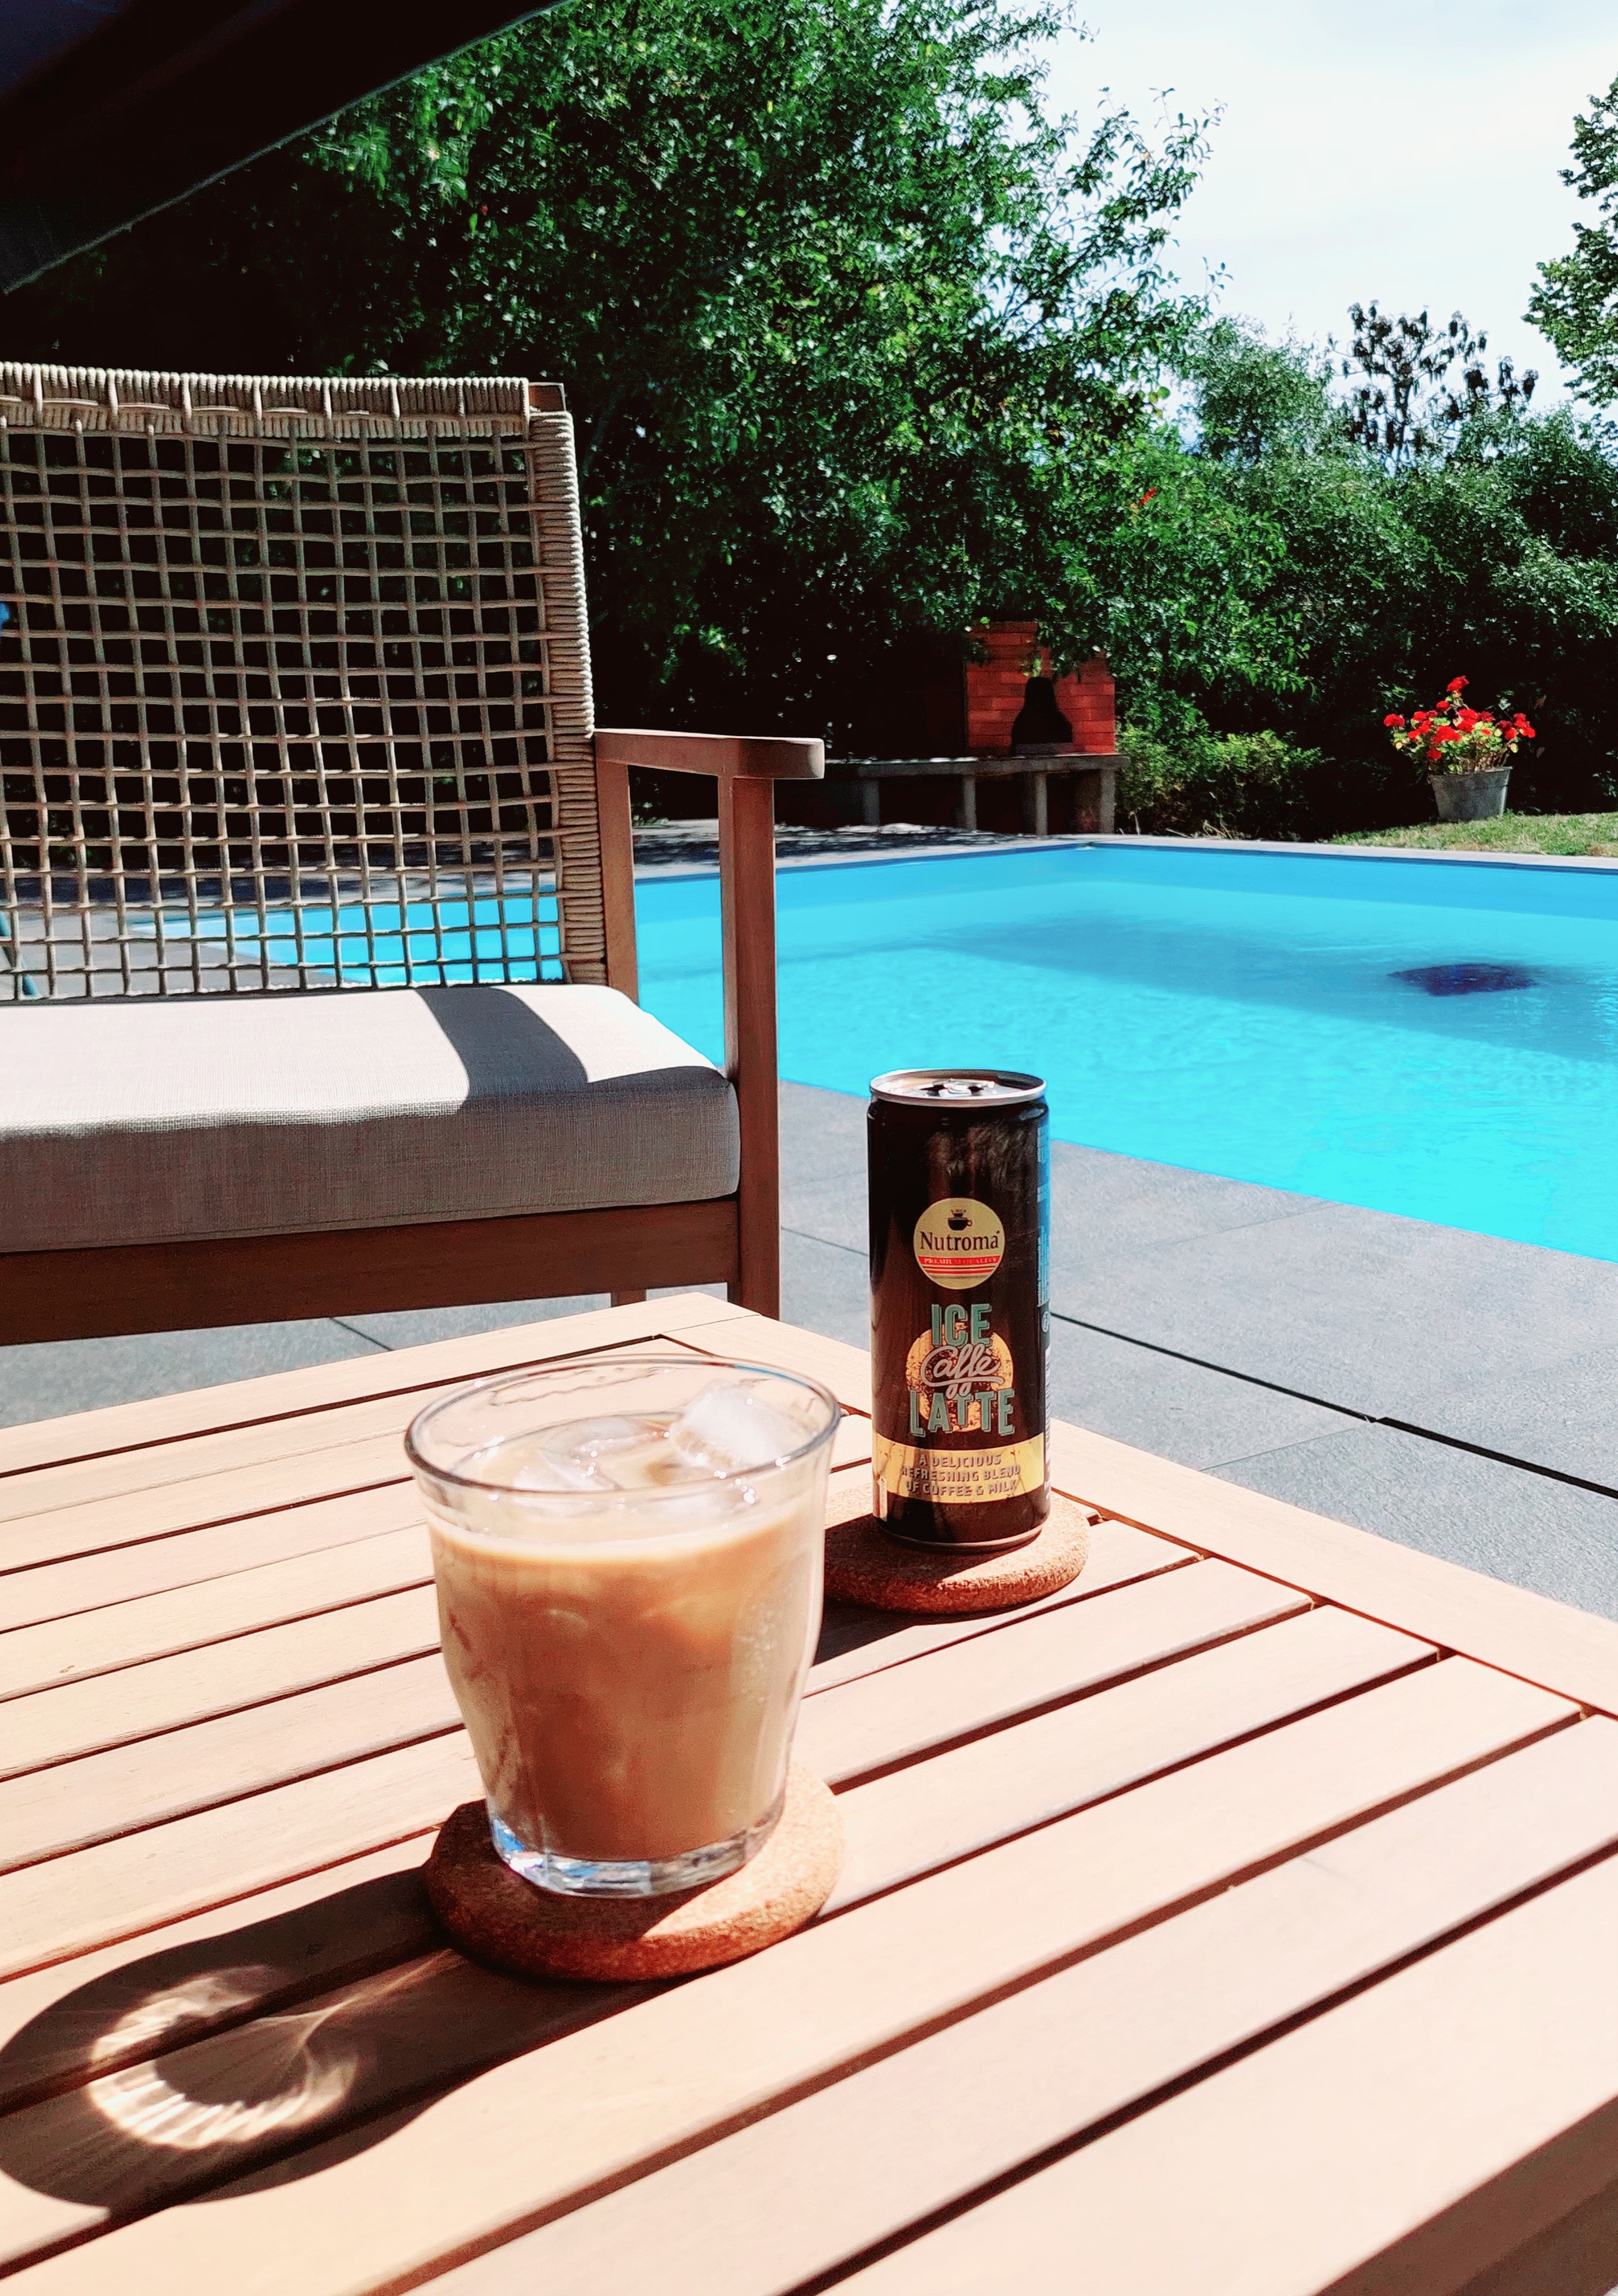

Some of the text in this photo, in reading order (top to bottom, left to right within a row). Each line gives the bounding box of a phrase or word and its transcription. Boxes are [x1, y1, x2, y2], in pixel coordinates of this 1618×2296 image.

[919, 1231, 999, 1251] Nutroma
[931, 1303, 992, 1347] ICE
[910, 1388, 1015, 1437] LATTE
[918, 1454, 1001, 1468] A DELICIOUS
[901, 1464, 1021, 1482] REFRESHING BLEND
[906, 1479, 1018, 1496] OF COFFEE & MILK
